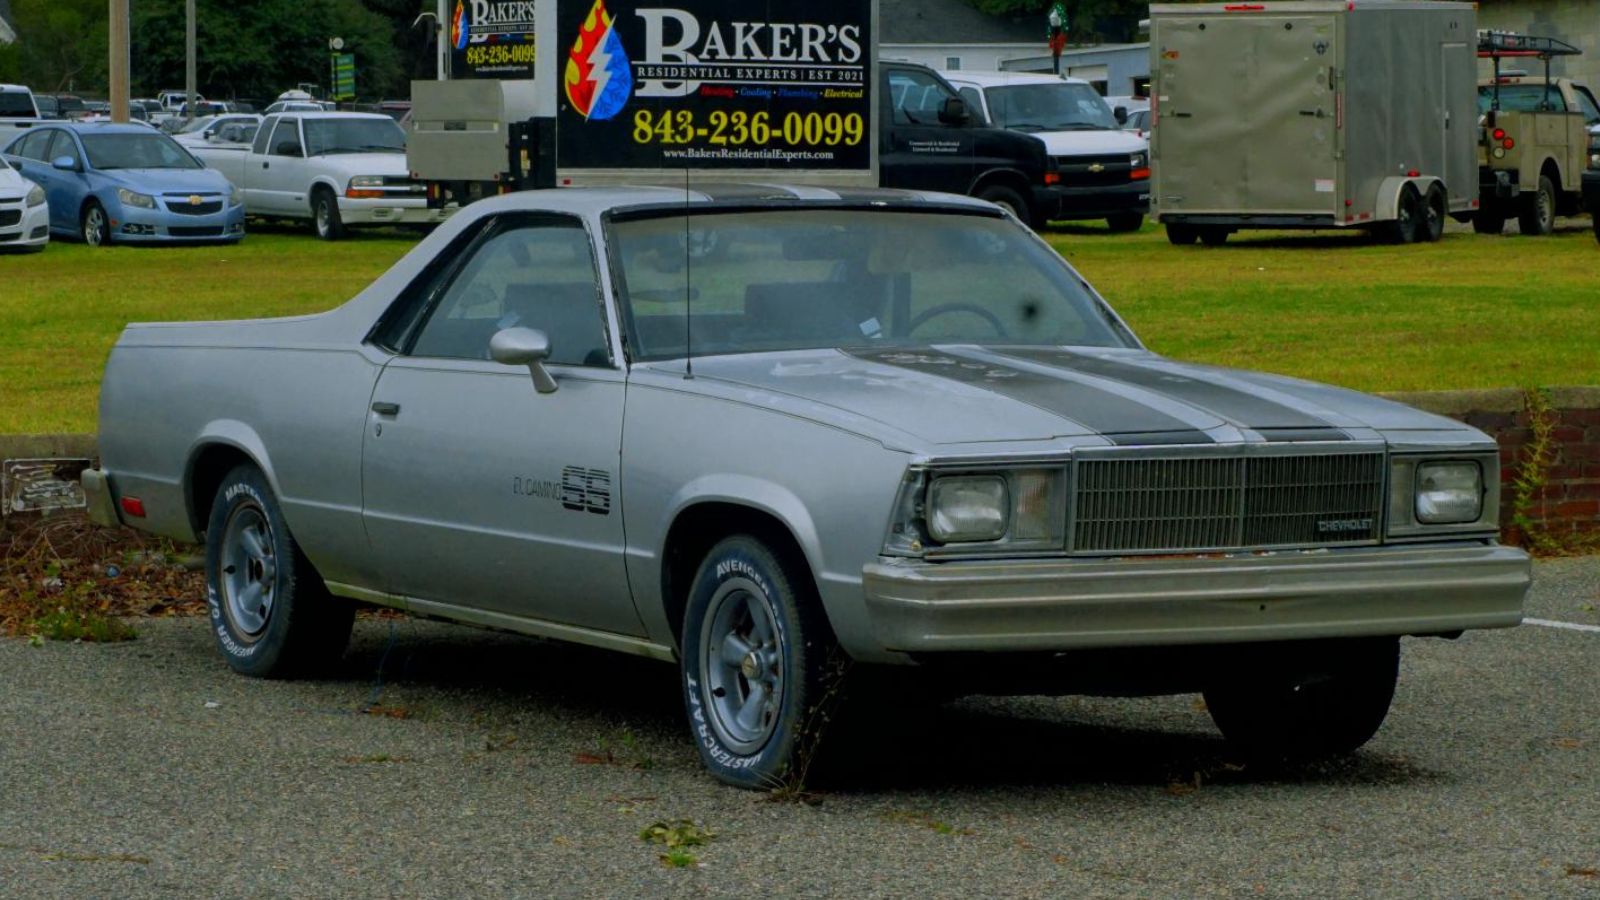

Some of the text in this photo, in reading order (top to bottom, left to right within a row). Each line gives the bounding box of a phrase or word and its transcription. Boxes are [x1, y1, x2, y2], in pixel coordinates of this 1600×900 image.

[469, 0, 535, 43] BAKER'S
[634, 8, 862, 97] BAKER'S
[637, 66, 864, 82] RESIDENTIAL EXPERTS EST 2021
[824, 89, 863, 99] Electrical
[632, 109, 864, 146] 843-236-0099
[663, 148, 835, 162] www.BakersResidentialExperts.com
[1318, 518, 1373, 532] CHEVROLET
